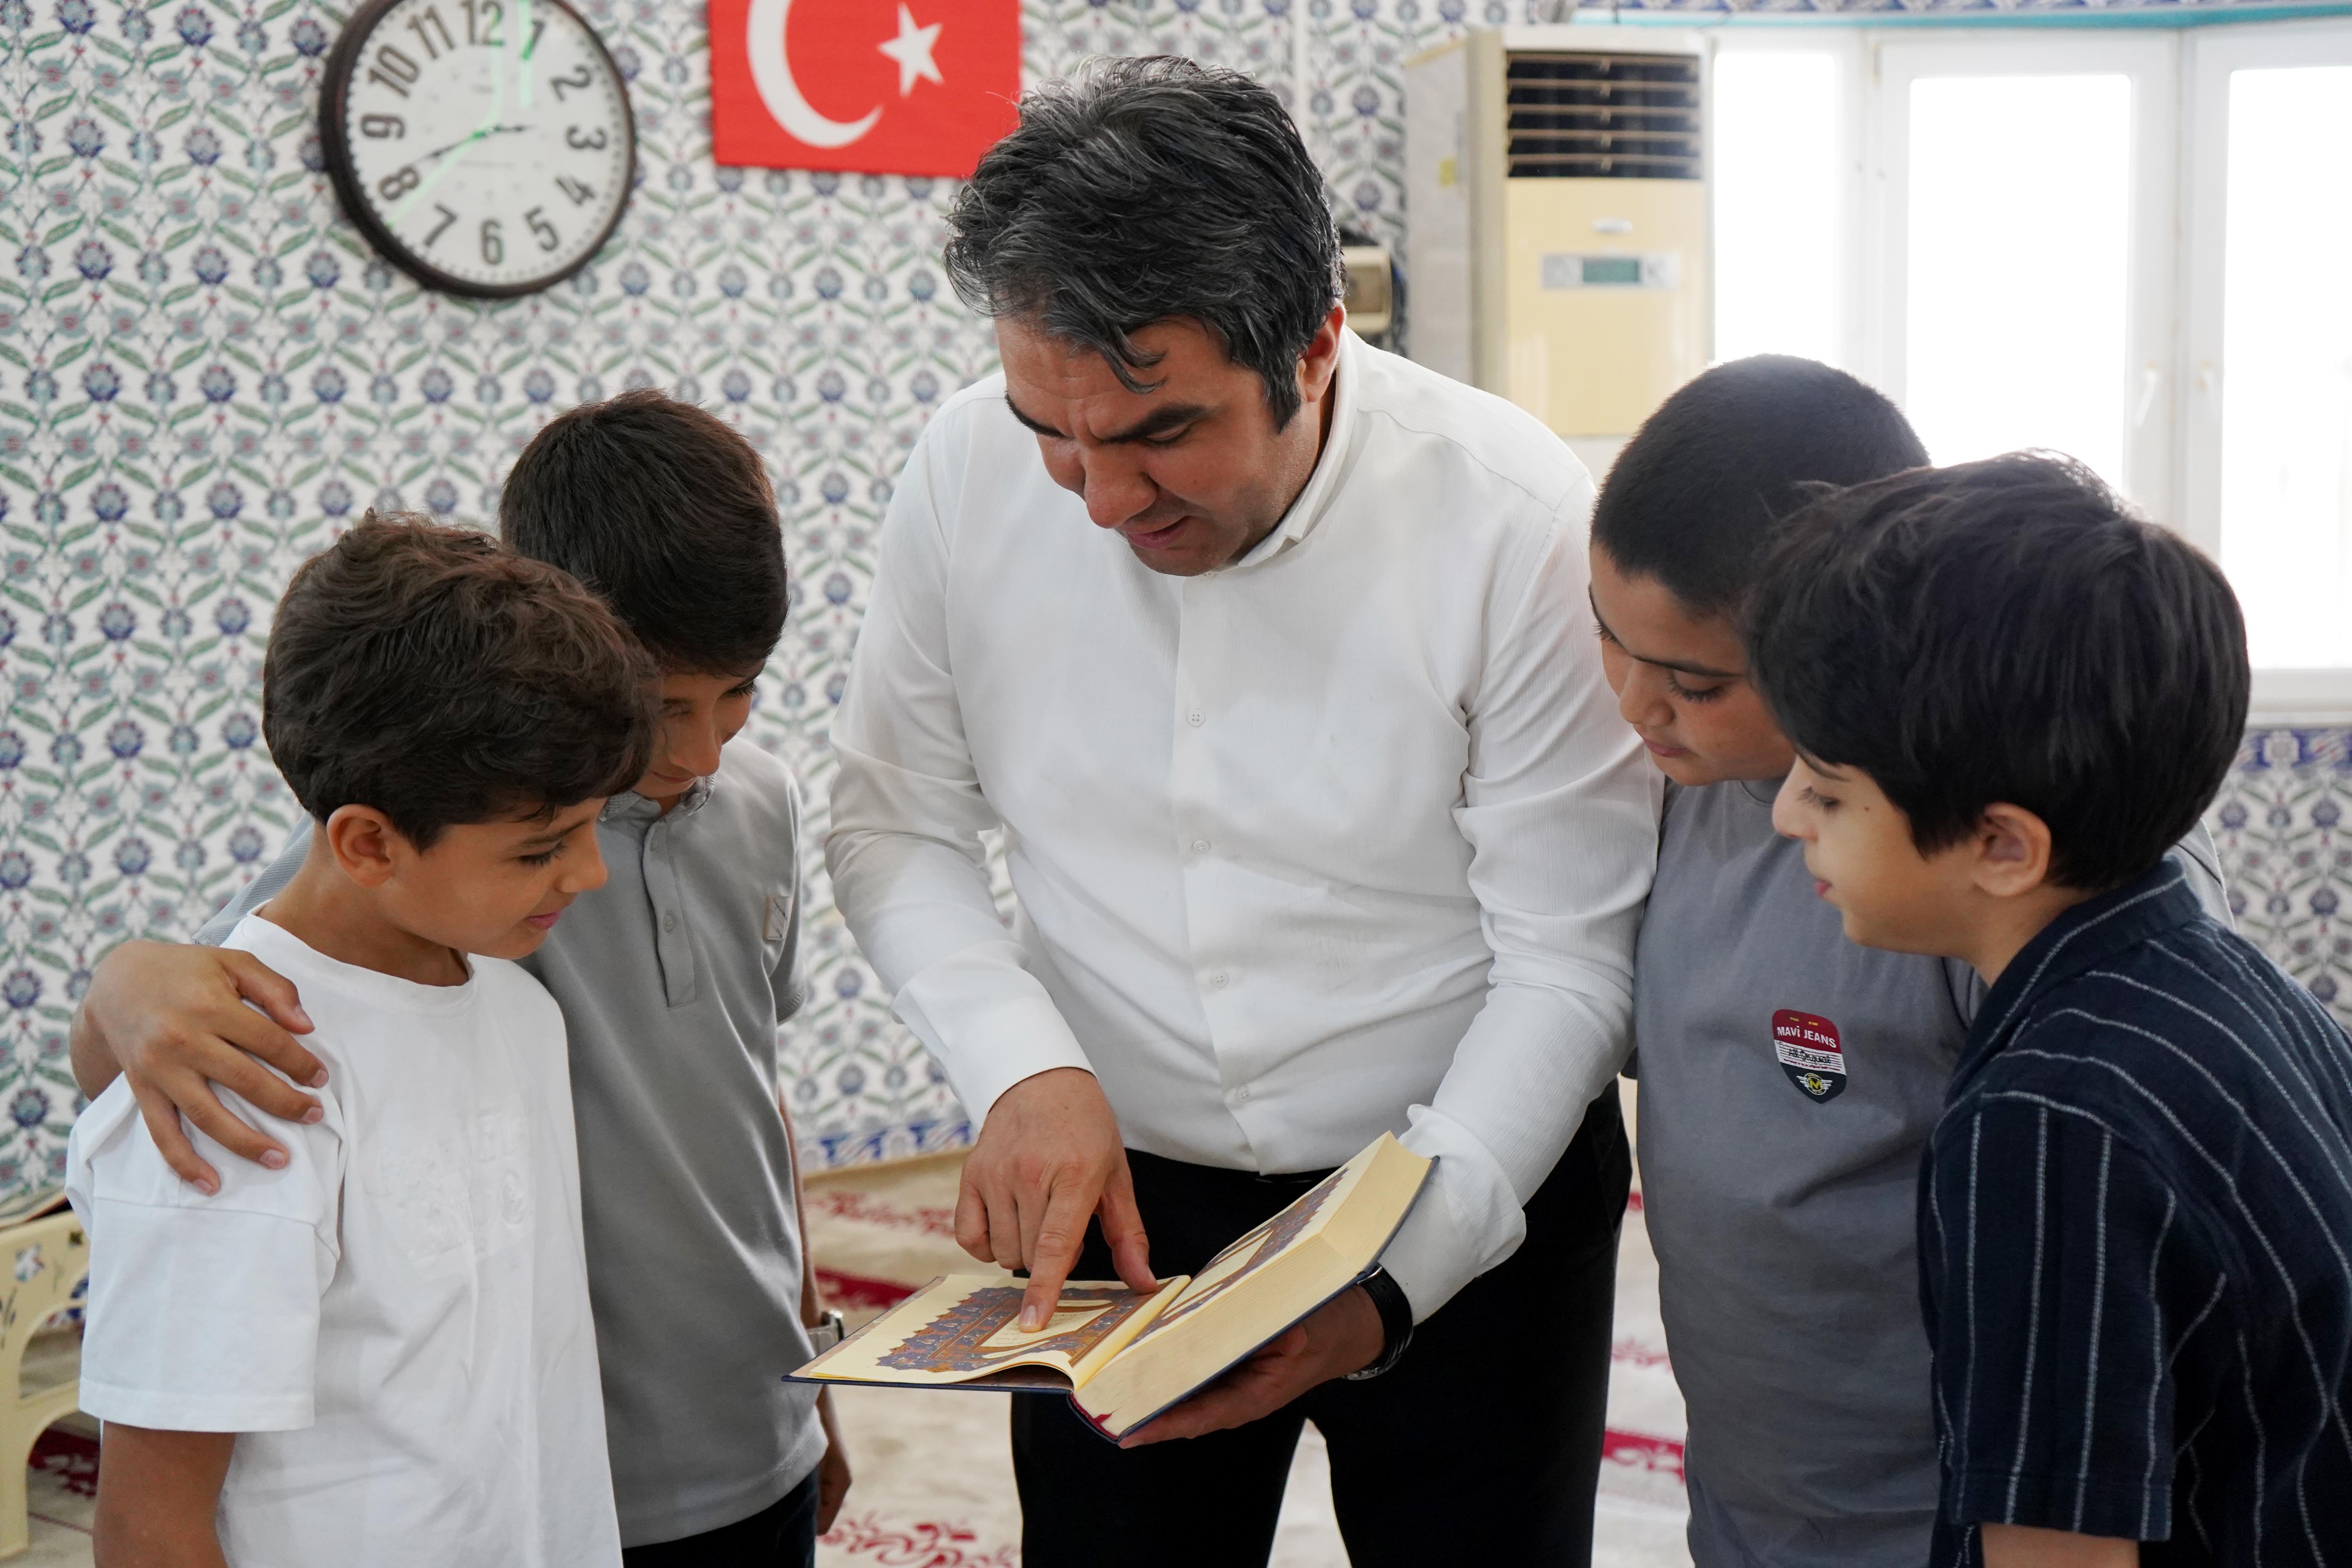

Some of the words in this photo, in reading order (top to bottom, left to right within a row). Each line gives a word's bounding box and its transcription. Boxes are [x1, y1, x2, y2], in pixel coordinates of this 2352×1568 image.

[407, 6, 456, 59] 11
[460, 0, 503, 46] 12
[522, 20, 545, 60] 1
[367, 44, 421, 98] 10
[550, 65, 591, 101] 2
[360, 113, 405, 139] 9
[566, 125, 607, 151] 3
[377, 165, 420, 201] 8
[554, 175, 596, 206] 4
[425, 203, 457, 247] 7
[480, 218, 503, 265] 6
[524, 206, 559, 251] 5
[1804, 1029, 1837, 1048] JEANS
[1808, 1078, 1823, 1090] M
